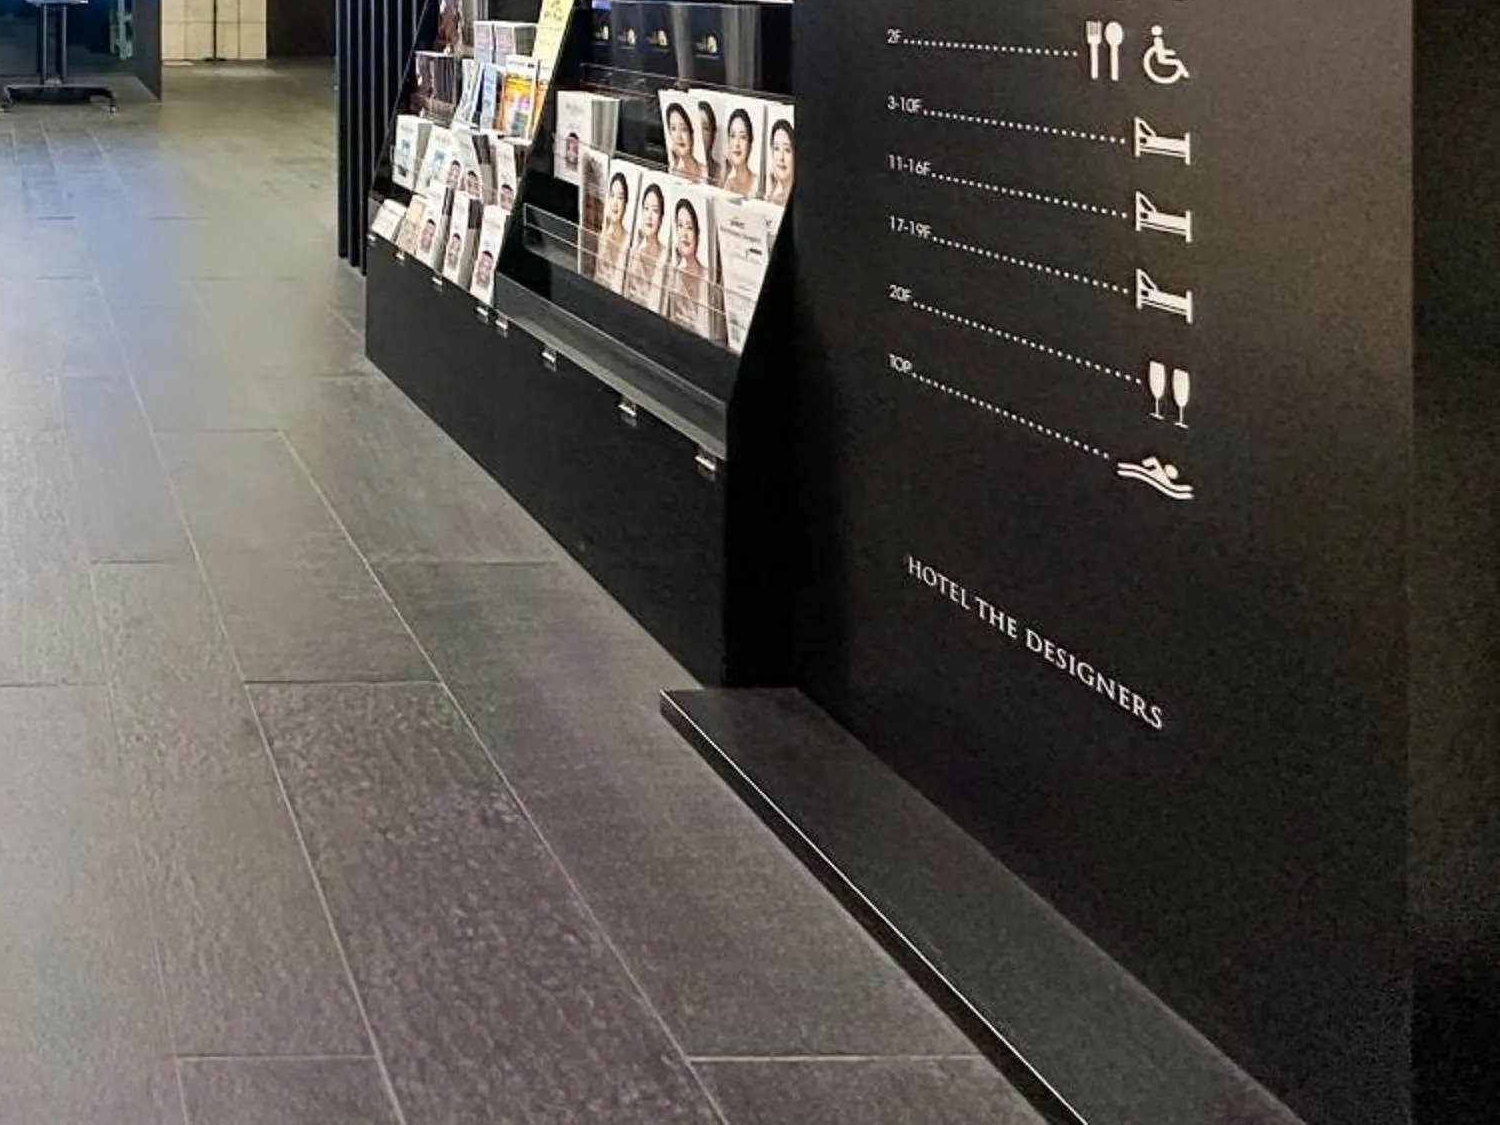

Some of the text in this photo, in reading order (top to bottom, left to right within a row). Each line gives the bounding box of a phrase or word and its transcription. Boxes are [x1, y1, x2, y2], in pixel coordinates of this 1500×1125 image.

[887, 29, 902, 45] 2F
[887, 95, 923, 114] 3-10F
[888, 154, 931, 176] 11-16F
[888, 215, 933, 239] 17-19F
[889, 284, 912, 303] 20F
[907, 555, 1163, 730] HOTEL THE DESIGNERS
